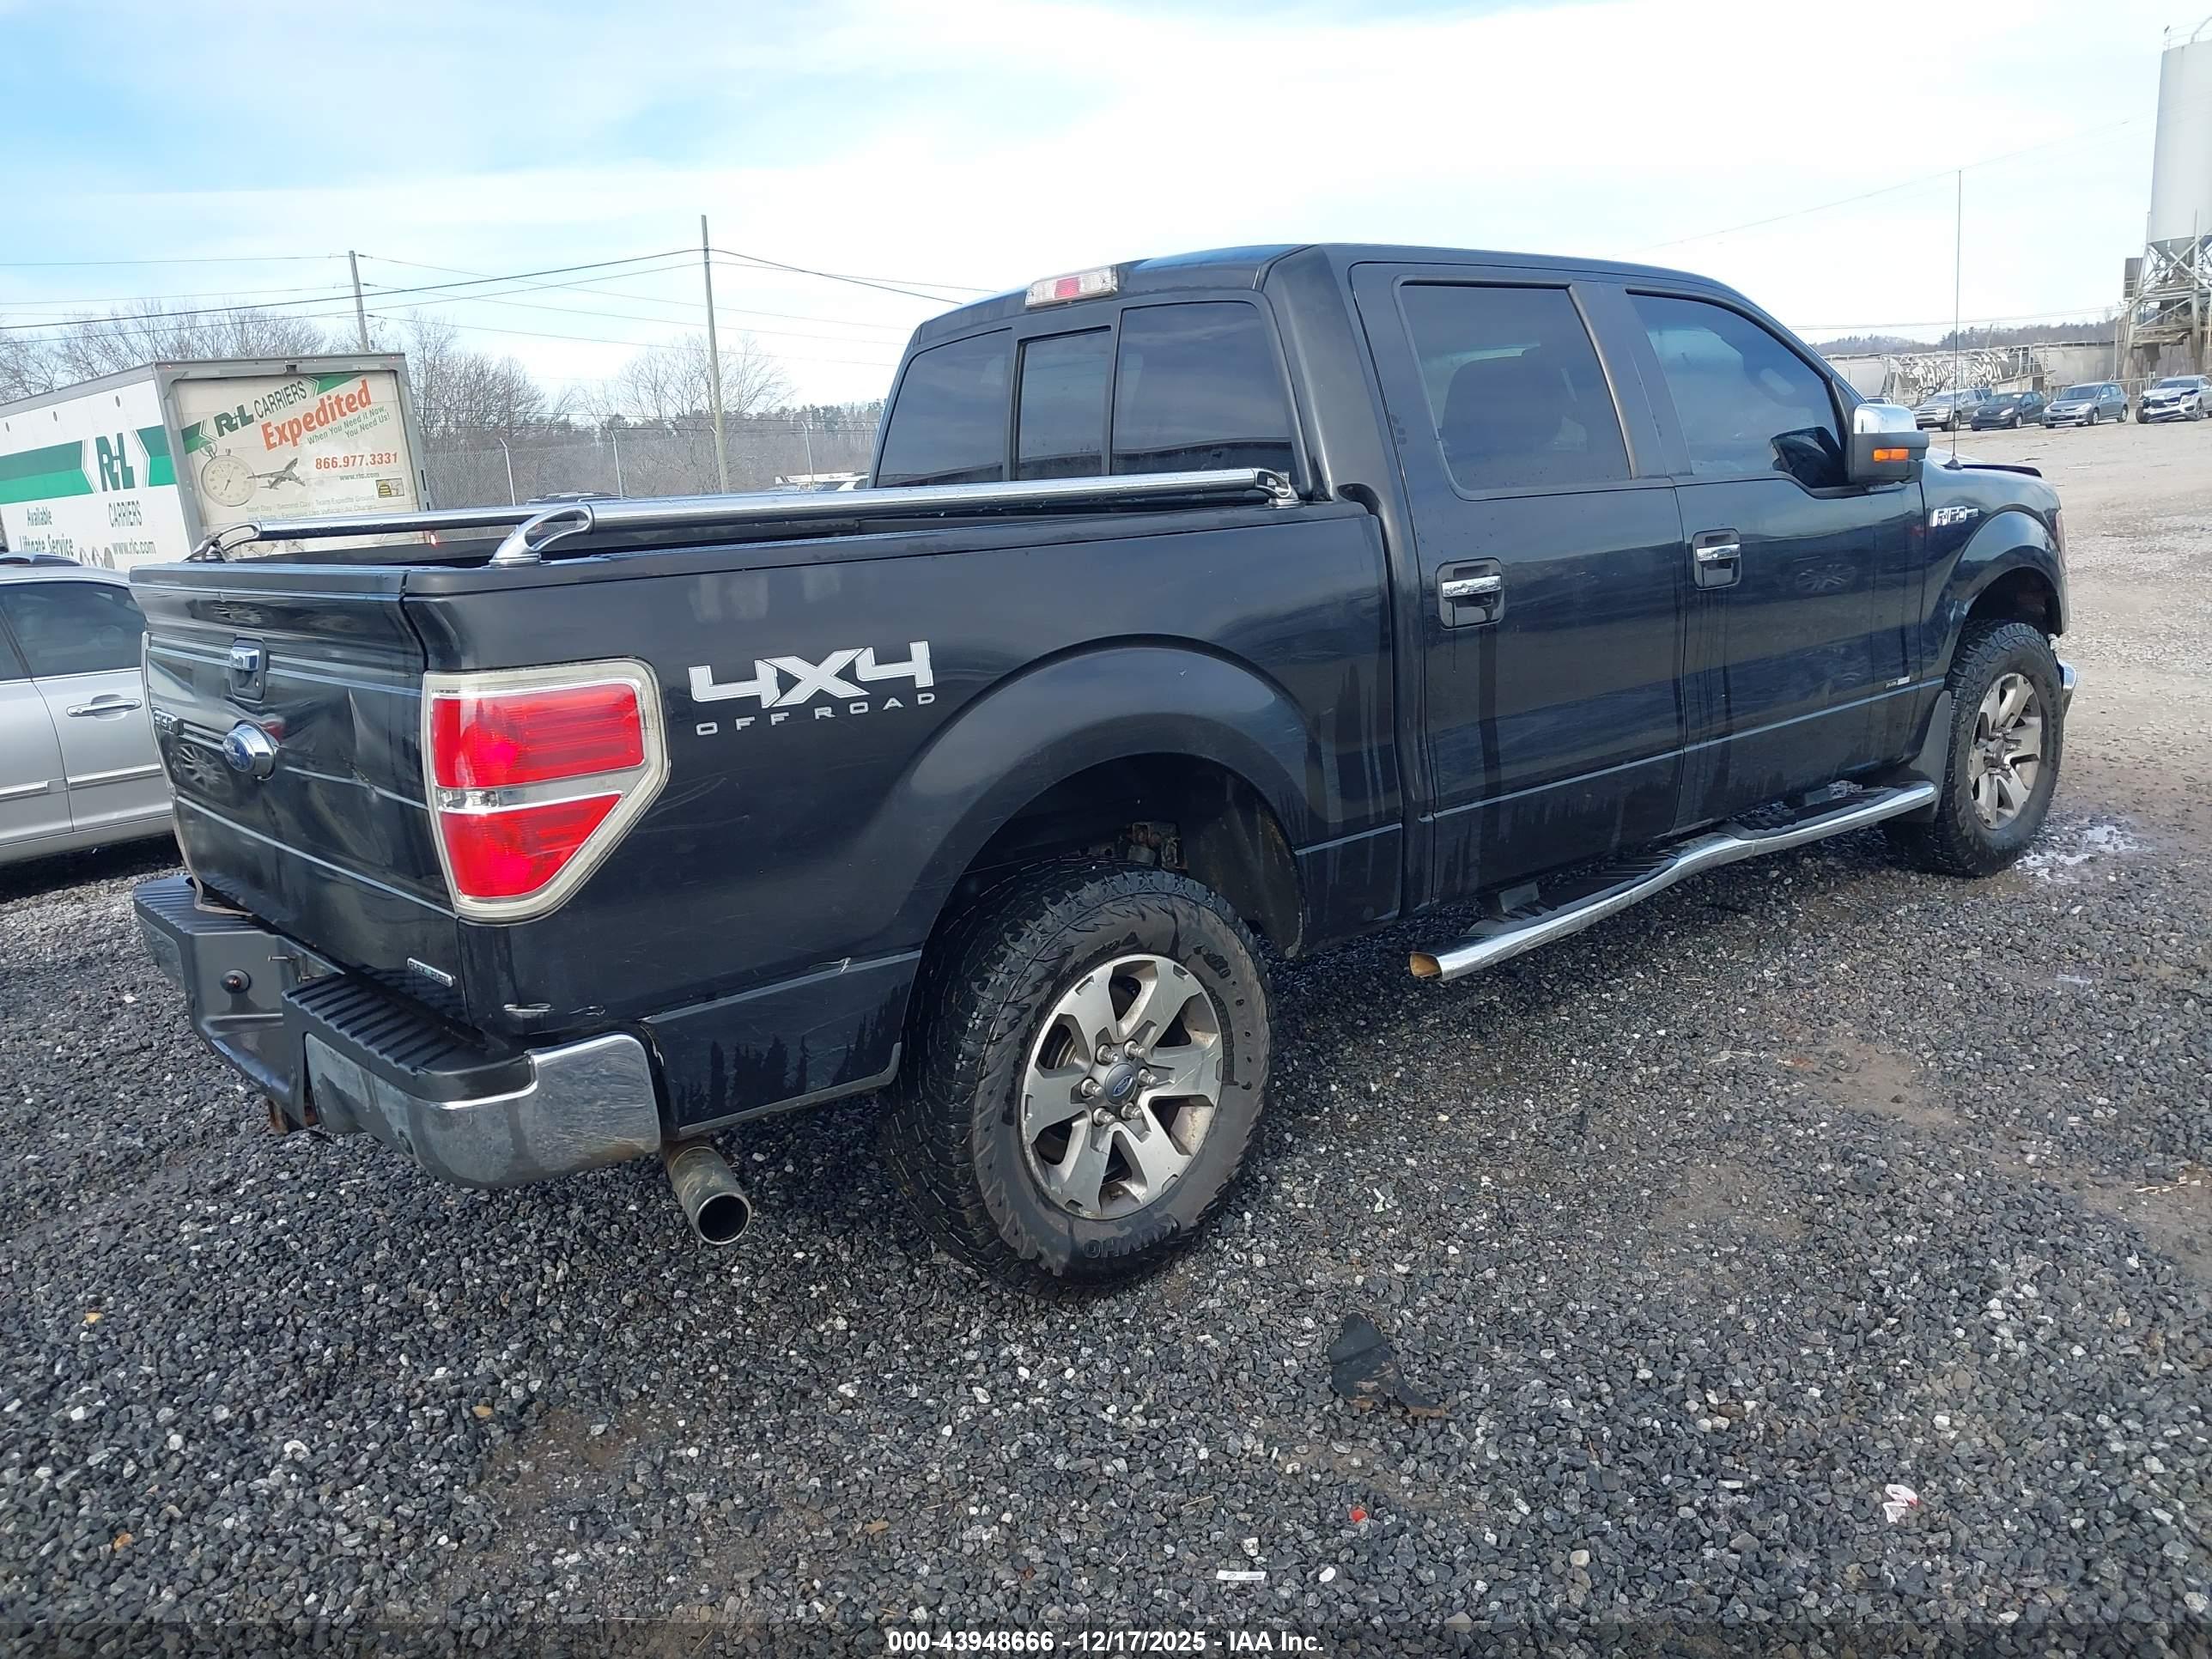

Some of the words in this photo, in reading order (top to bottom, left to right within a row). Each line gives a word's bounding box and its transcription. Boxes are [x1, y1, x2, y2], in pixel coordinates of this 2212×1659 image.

[254, 380, 307, 418] CARRIERS
[261, 380, 372, 451] Expedited
[345, 429, 358, 439] You
[360, 417, 378, 431] Need
[378, 411, 391, 423] Us!
[307, 432, 328, 445] When
[329, 425, 343, 435] You
[343, 416, 361, 429] Need
[315, 452, 398, 470] 866.977.3331
[339, 472, 380, 481] www.rlc.com
[27, 507, 52, 526] Available
[108, 500, 143, 528] CARRIERS
[48, 533, 74, 556] Service
[112, 538, 156, 555] www.rlc.com
